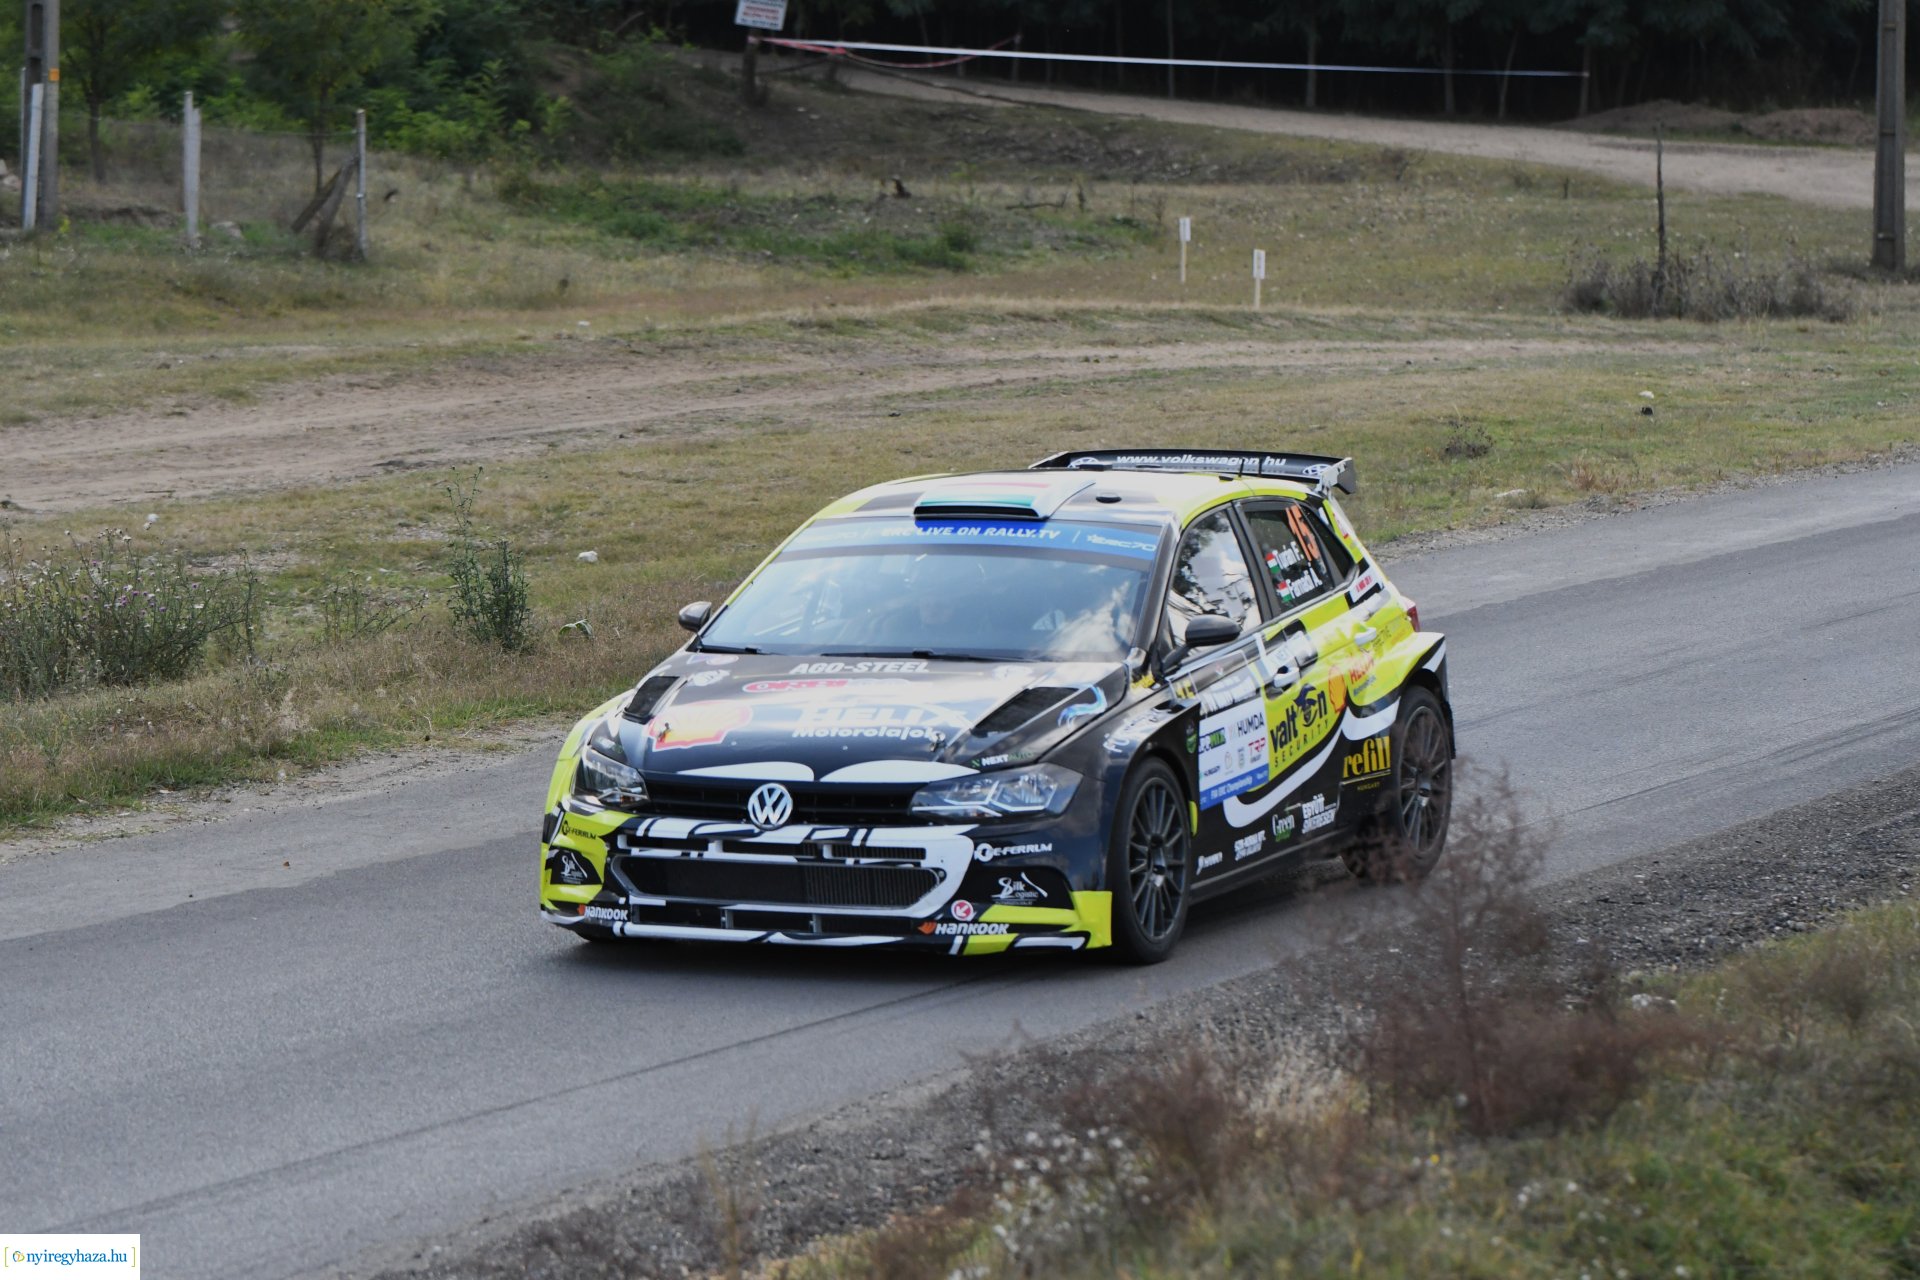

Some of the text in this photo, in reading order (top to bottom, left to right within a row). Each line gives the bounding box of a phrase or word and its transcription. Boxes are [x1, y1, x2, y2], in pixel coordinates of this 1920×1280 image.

[1117, 454, 1287, 466] www.volkswagenhu
[916, 526, 954, 537] LIVE
[957, 527, 982, 536] ON
[983, 527, 1061, 539] RALLY.TV
[788, 661, 930, 675] AGO-STEEL
[1274, 719, 1328, 768] SECURITY
[1343, 735, 1391, 779] refill
